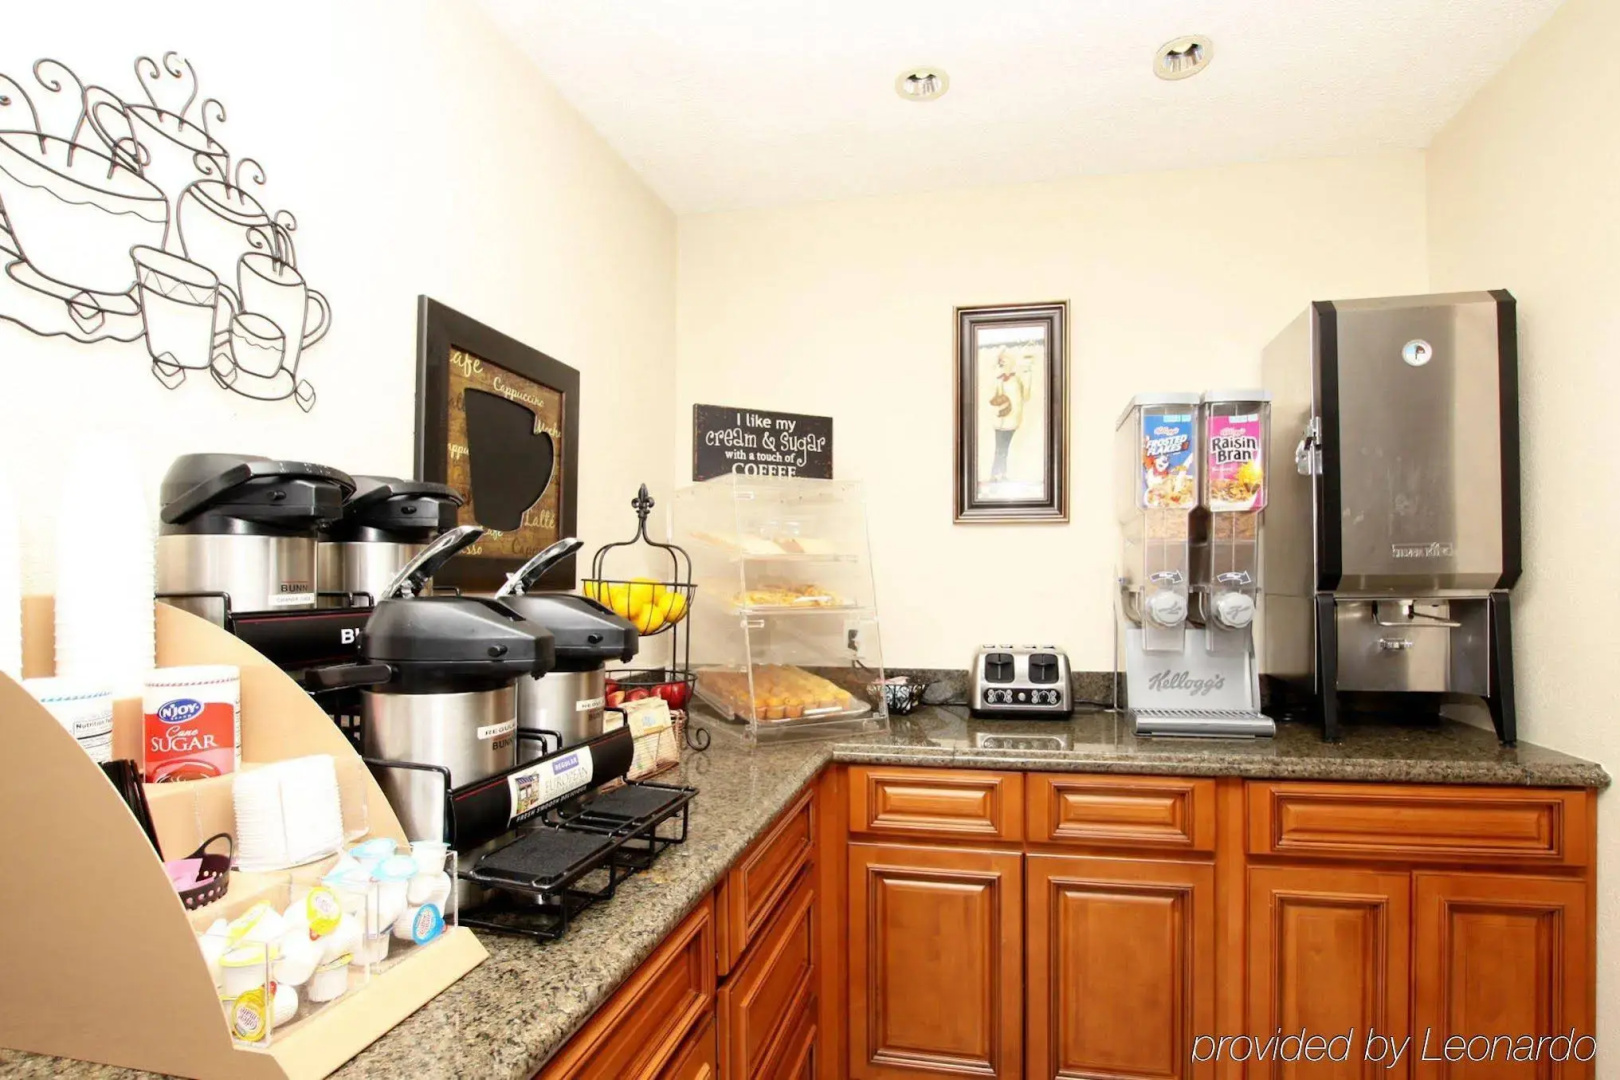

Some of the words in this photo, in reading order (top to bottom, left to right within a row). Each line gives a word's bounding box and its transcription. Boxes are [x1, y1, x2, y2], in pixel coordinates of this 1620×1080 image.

[450, 351, 483, 377] afe
[493, 376, 544, 407] Cappuccino
[736, 412, 741, 426] I
[746, 412, 772, 428] like
[776, 419, 797, 433] my
[705, 427, 757, 448] cream
[762, 431, 777, 452] &
[1212, 437, 1256, 452] Raisin
[725, 449, 747, 461] with
[749, 452, 755, 461] a
[757, 451, 783, 463] touch
[785, 452, 796, 464] of
[1218, 449, 1252, 463] Bran
[281, 584, 308, 592] BUNN
[1148, 669, 1225, 696] Kellogg's
[166, 725, 199, 739] Cane
[151, 734, 219, 753] SUGAR
[554, 756, 577, 771] REGULAR
